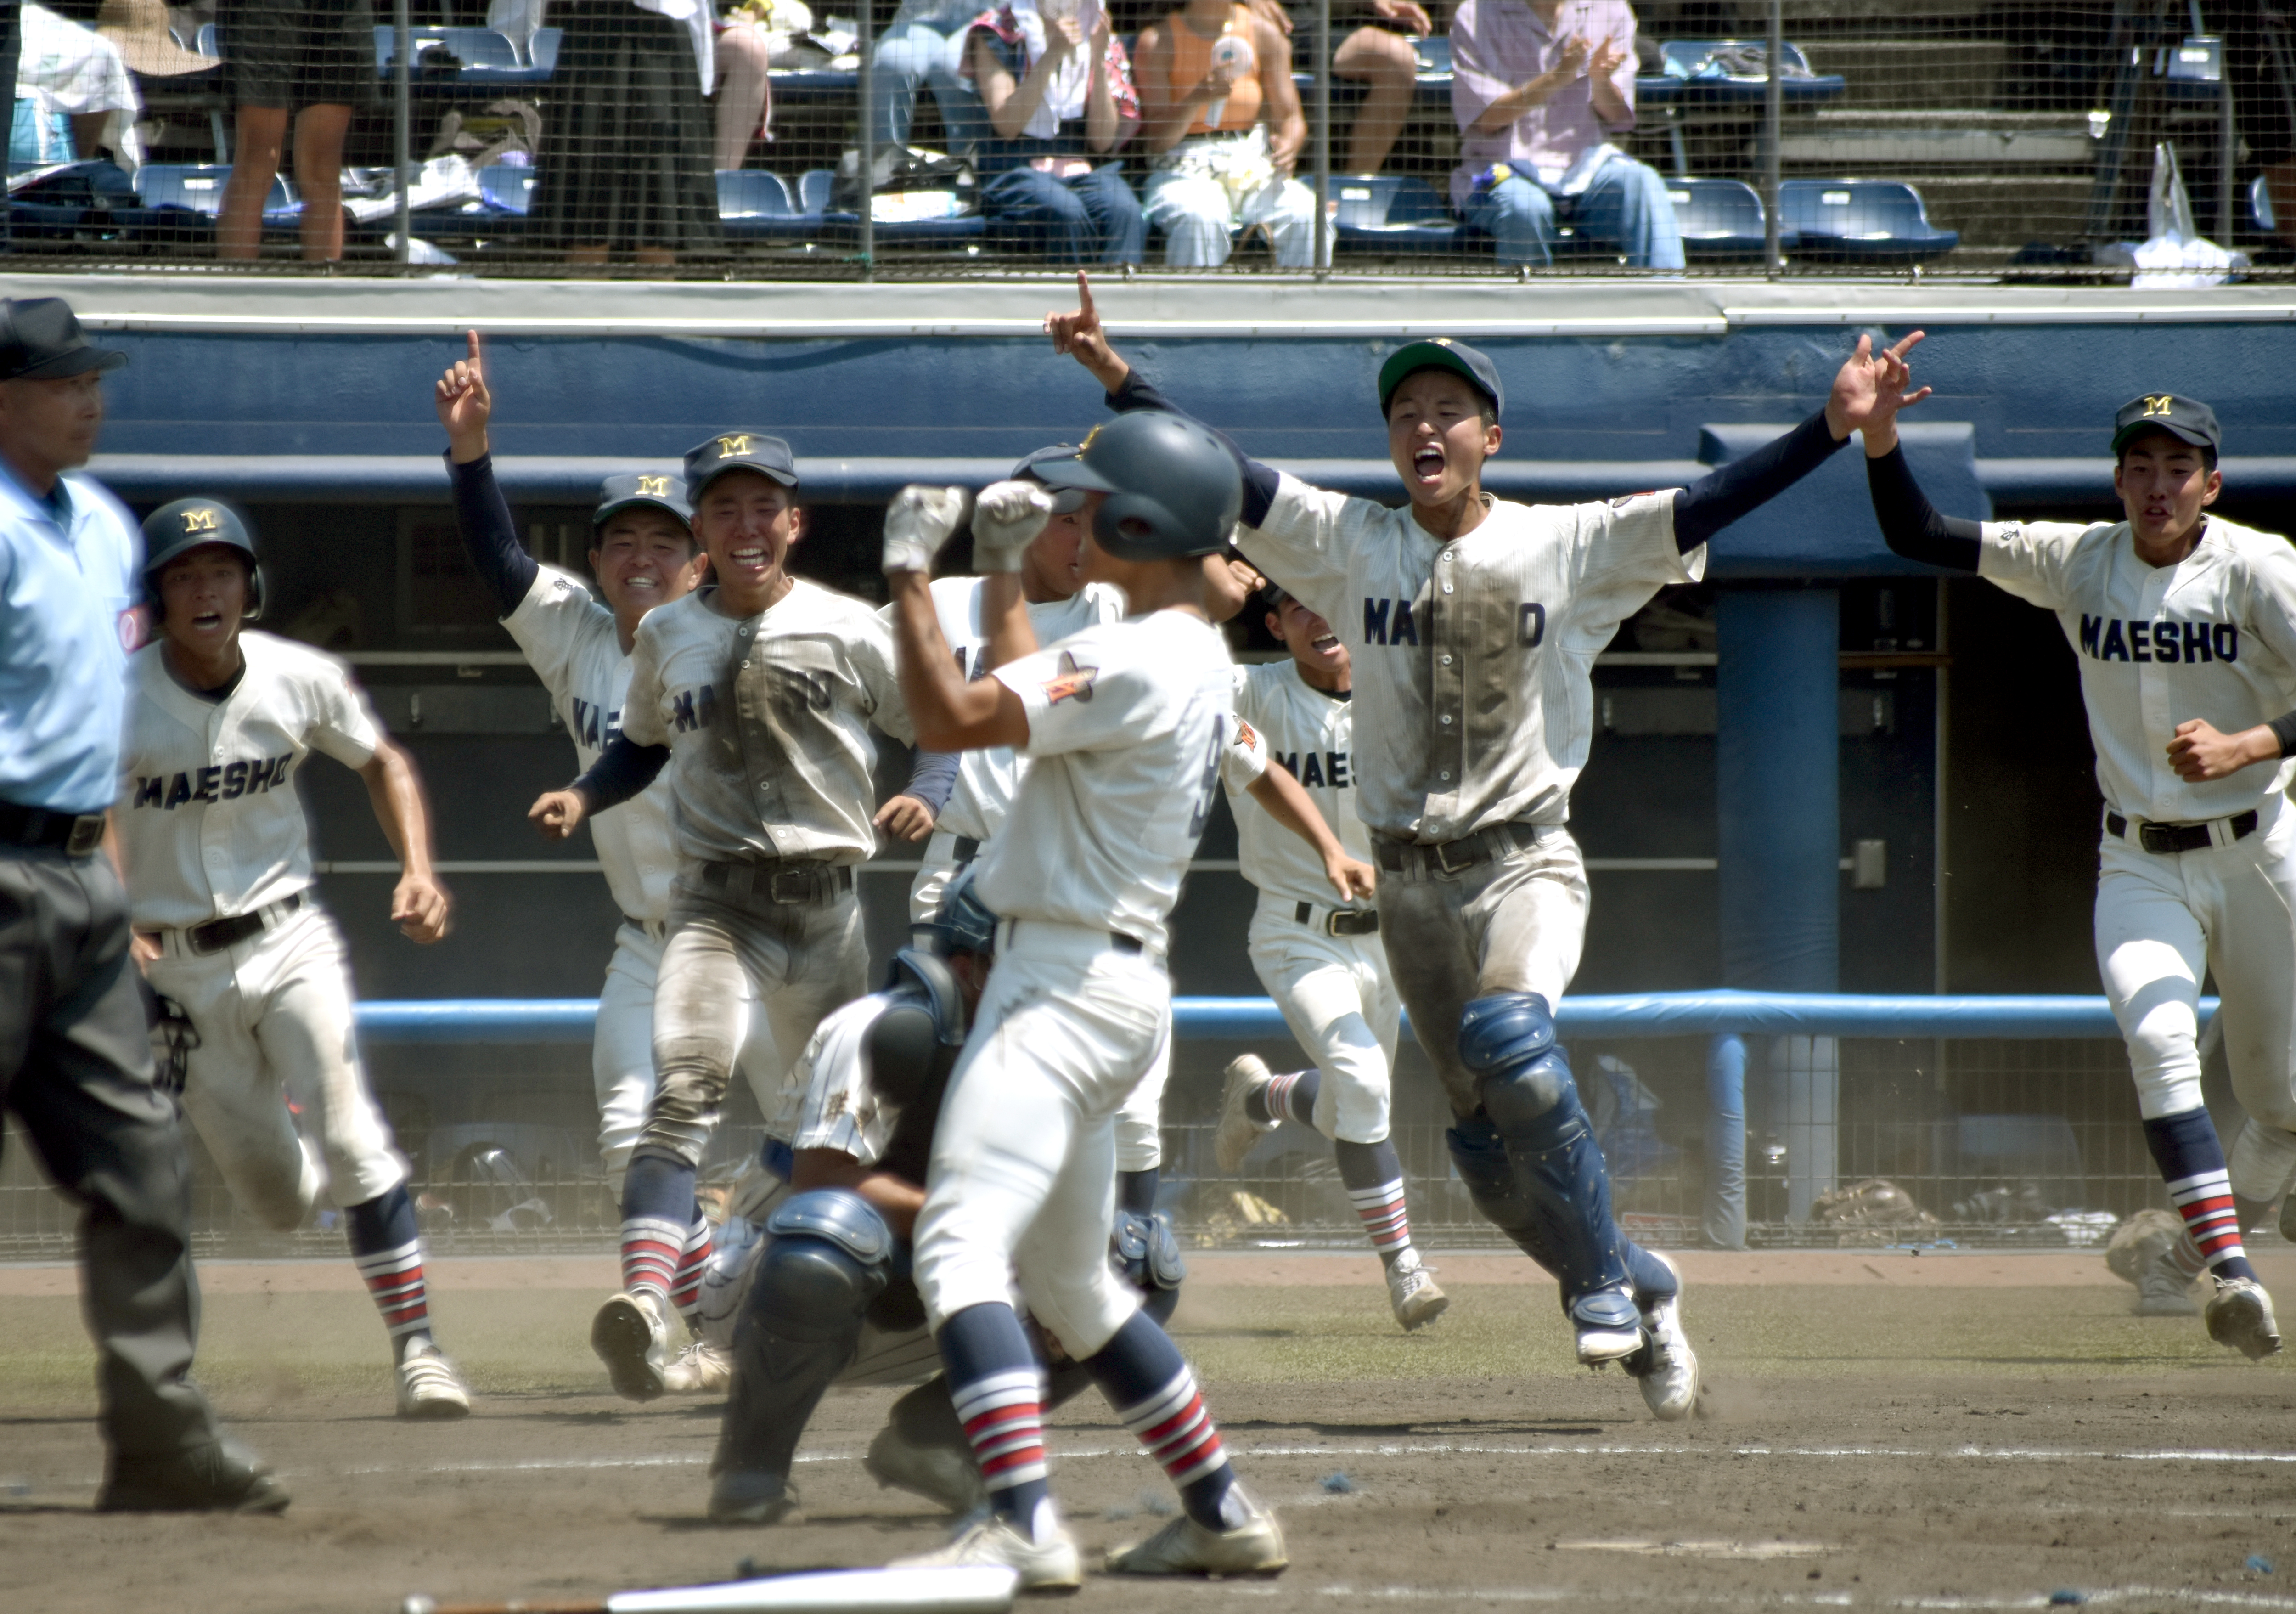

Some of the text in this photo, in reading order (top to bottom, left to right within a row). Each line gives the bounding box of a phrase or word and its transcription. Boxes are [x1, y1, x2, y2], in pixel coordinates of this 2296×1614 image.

[2143, 395, 2172, 416] M
[718, 435, 751, 459] M
[635, 476, 668, 497] M
[180, 509, 218, 533] M
[2080, 613, 2238, 664] MAESHO
[133, 752, 293, 810] MAESHO
